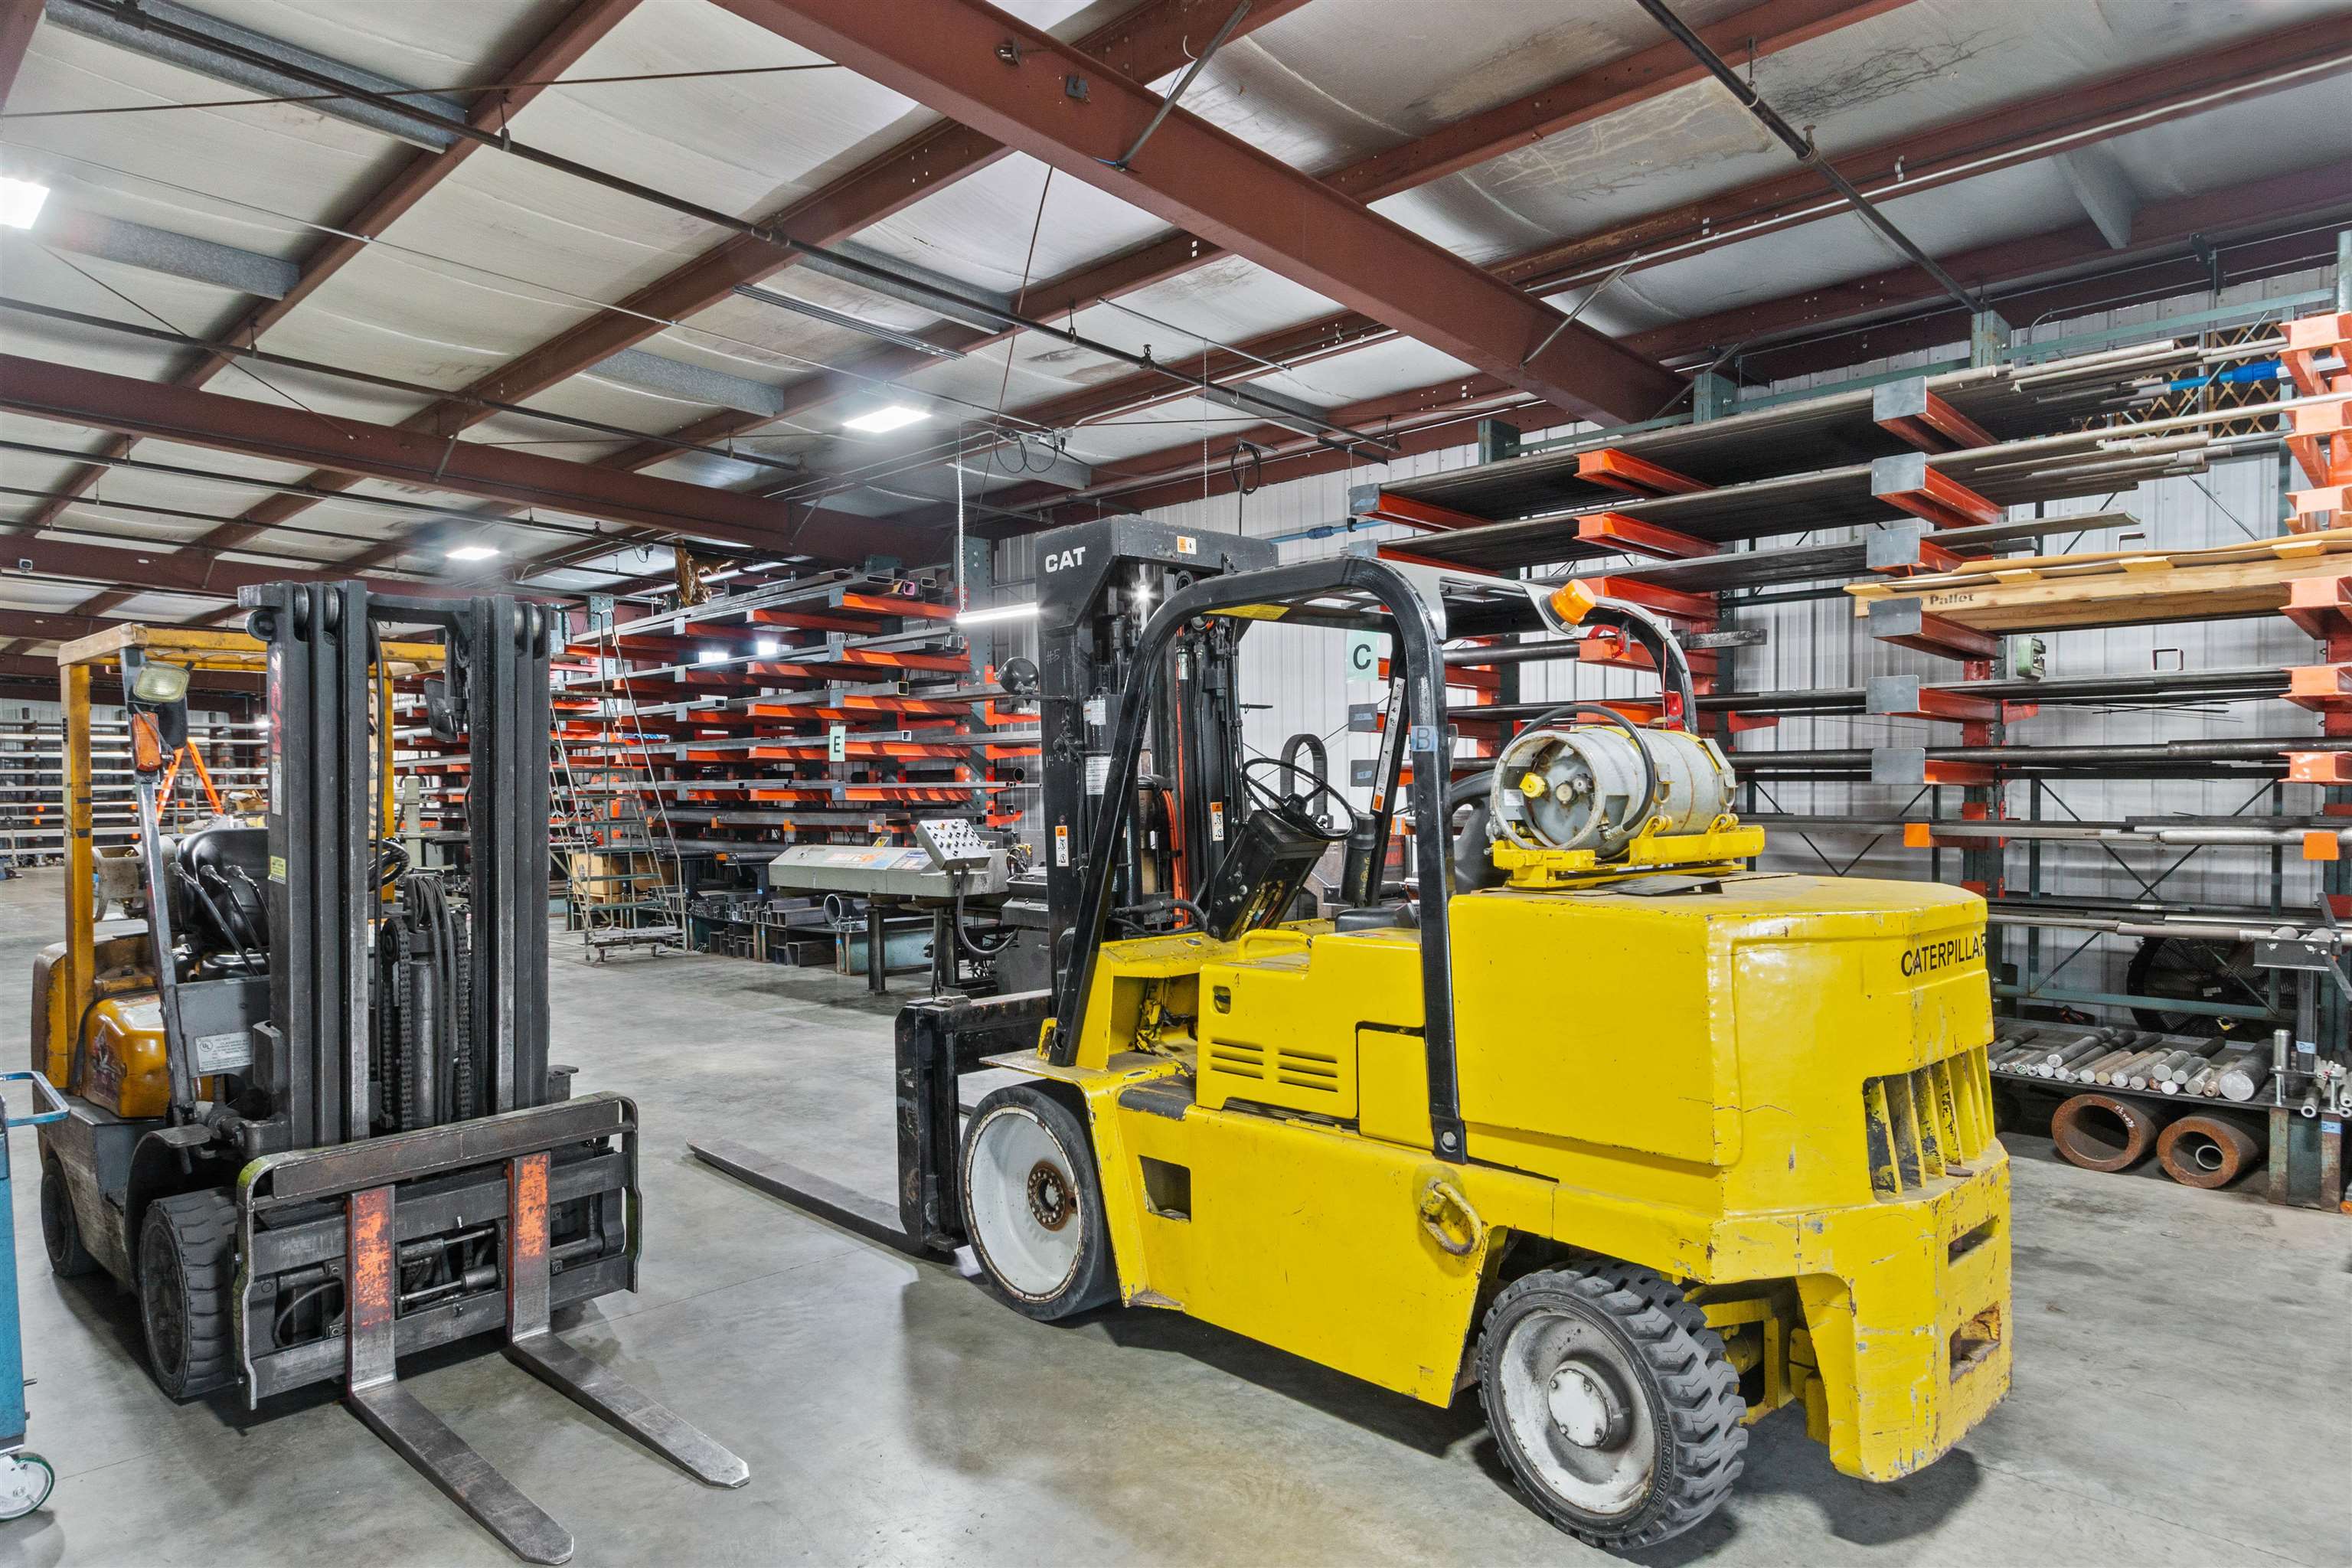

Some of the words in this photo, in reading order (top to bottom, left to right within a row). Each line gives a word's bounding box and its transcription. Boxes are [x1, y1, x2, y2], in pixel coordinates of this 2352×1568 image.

[1045, 546, 1086, 573] CAT
[1929, 593, 1974, 605] Pallet
[1353, 644, 1371, 670] C
[833, 736, 841, 753] E
[1416, 727, 1430, 750] B
[1658, 1414, 1671, 1455] SUPER
[1658, 1455, 1671, 1488] SOLID
